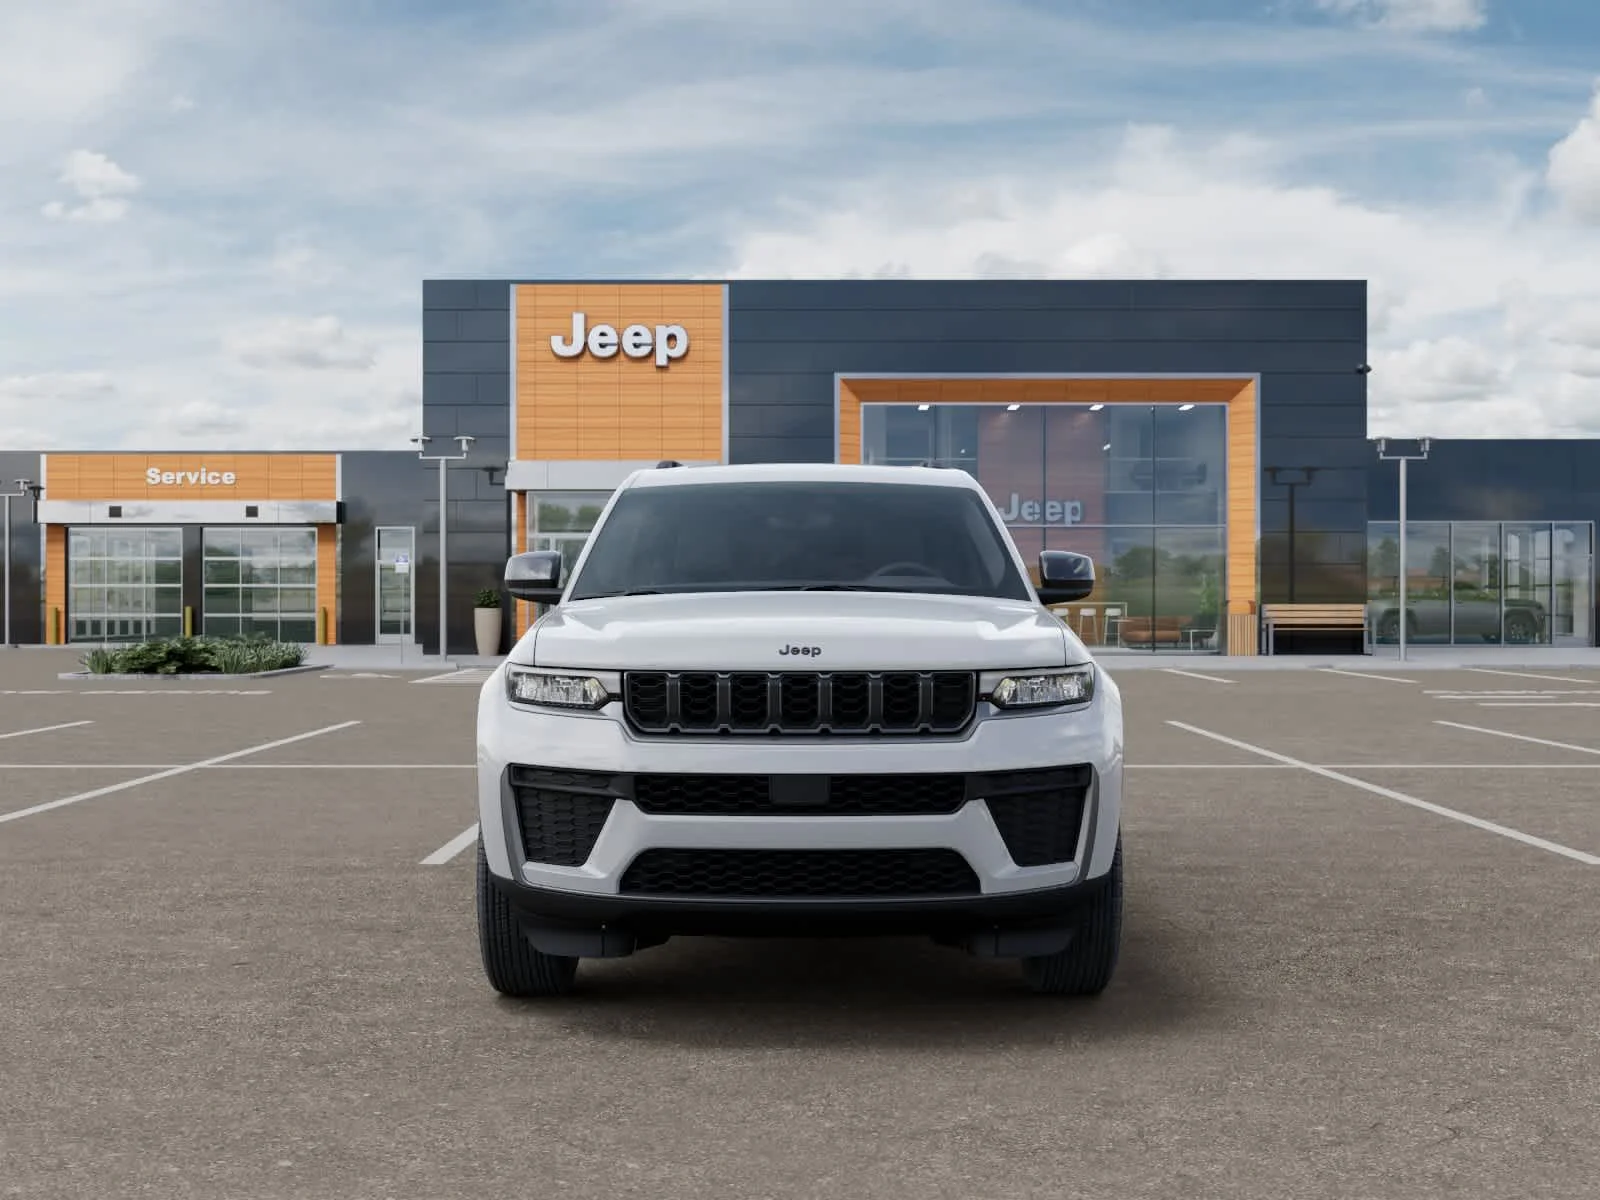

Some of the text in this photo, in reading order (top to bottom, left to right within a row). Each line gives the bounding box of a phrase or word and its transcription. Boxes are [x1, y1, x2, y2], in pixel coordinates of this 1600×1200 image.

[550, 312, 688, 367] Jeep
[146, 466, 236, 486] Service
[999, 493, 1083, 526] Jeep
[778, 644, 822, 658] Jeep
